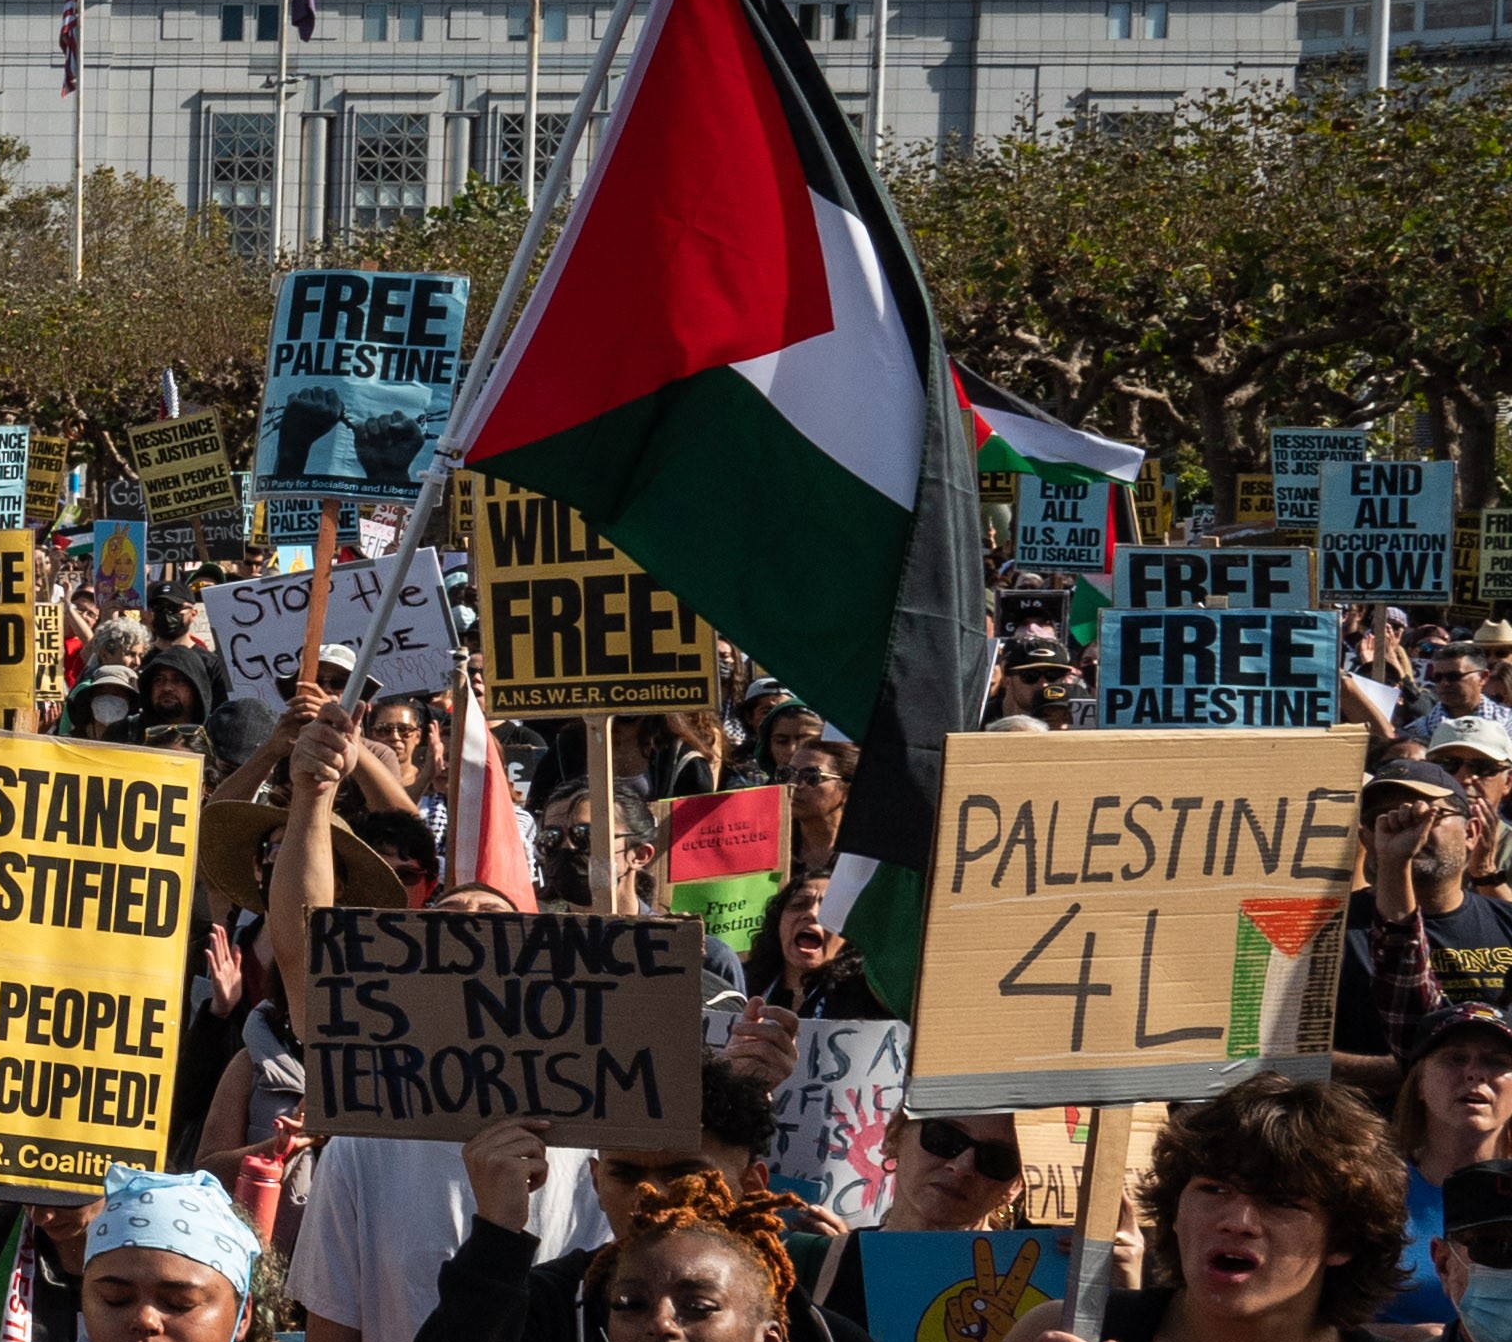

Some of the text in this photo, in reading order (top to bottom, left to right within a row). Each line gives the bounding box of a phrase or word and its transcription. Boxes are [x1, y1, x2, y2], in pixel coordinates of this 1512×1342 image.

[285, 275, 454, 347] FREE
[272, 343, 454, 385] PALESTINE
[1349, 464, 1422, 497] END
[1353, 499, 1417, 529] ALL
[1321, 533, 1447, 553] OCCUPATION
[1322, 552, 1443, 592] NOW!
[489, 574, 701, 682] FREE!
[1118, 615, 1318, 689] FREE
[497, 683, 703, 708] A.N.S.W.E.R. Coalition
[1106, 687, 1331, 729] PALESTINE
[950, 790, 1358, 896] PALESTINE
[310, 908, 686, 976] RESISTANCE
[317, 977, 618, 1046] IS NOT
[310, 1041, 663, 1120] TERRORISM
